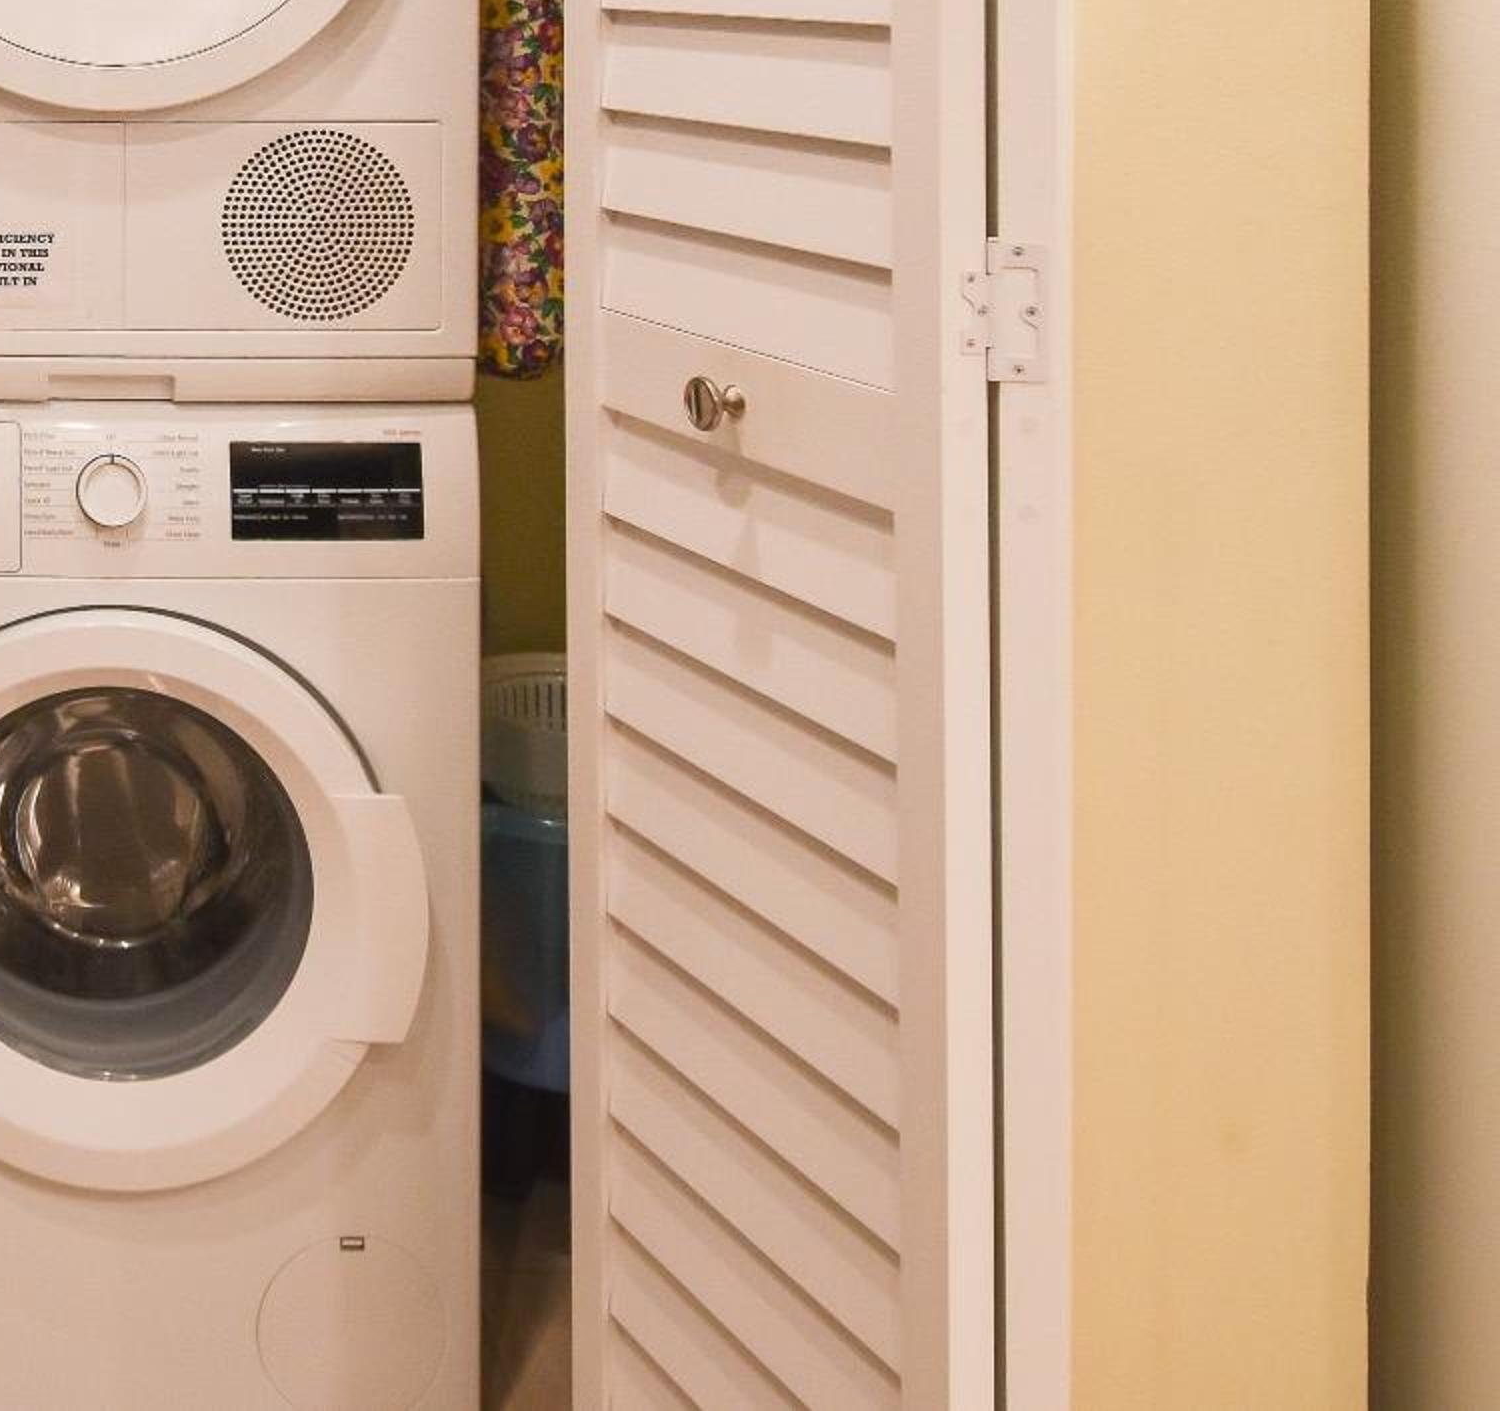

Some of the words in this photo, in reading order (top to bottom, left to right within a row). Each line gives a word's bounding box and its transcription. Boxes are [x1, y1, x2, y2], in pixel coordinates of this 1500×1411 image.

[1, 249, 16, 257] IN
[20, 249, 50, 257] THIS
[23, 277, 38, 285] IN
